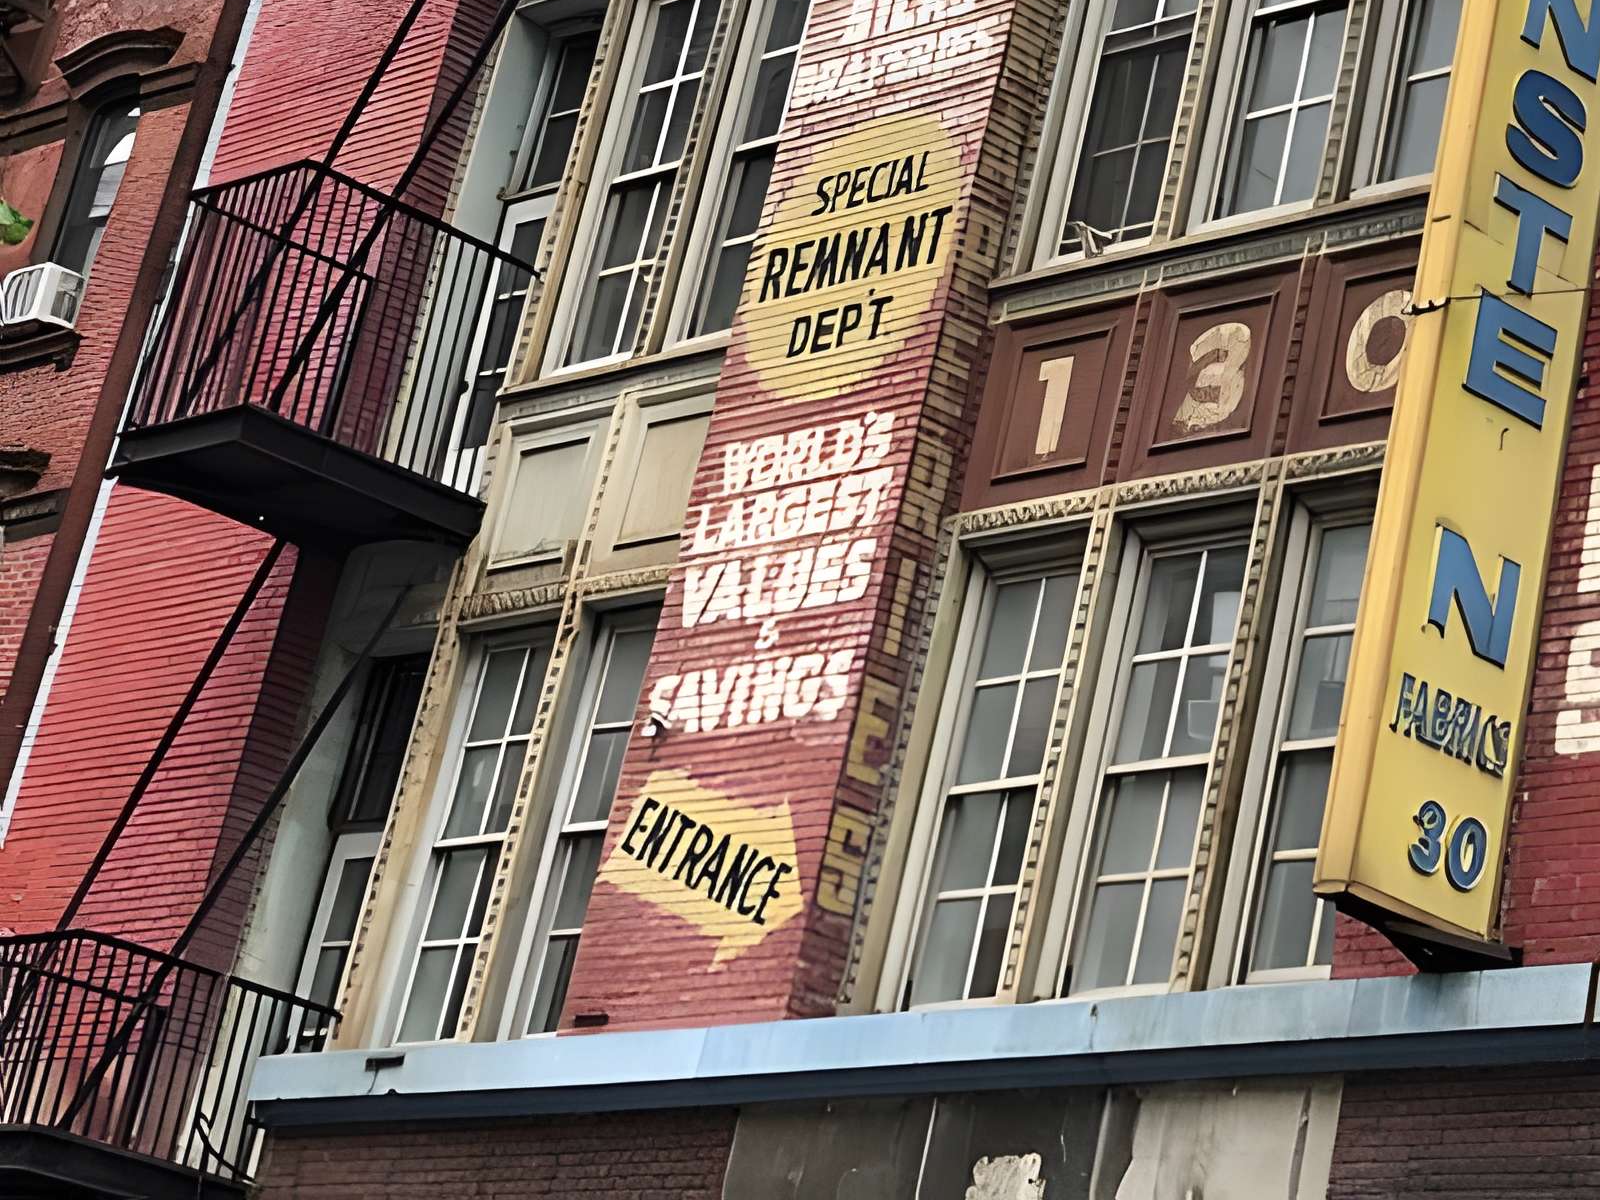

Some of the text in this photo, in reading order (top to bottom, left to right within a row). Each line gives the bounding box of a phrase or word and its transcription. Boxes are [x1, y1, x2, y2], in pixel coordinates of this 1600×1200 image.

[810, 150, 930, 216] SPECIAL
[758, 205, 953, 303] REMNANT
[686, 466, 896, 555] LARGEST
[683, 538, 877, 628] VALUES
[641, 649, 855, 737] SAVINGS
[620, 797, 792, 926] ENTRANCE
[1408, 800, 1487, 892] 30
